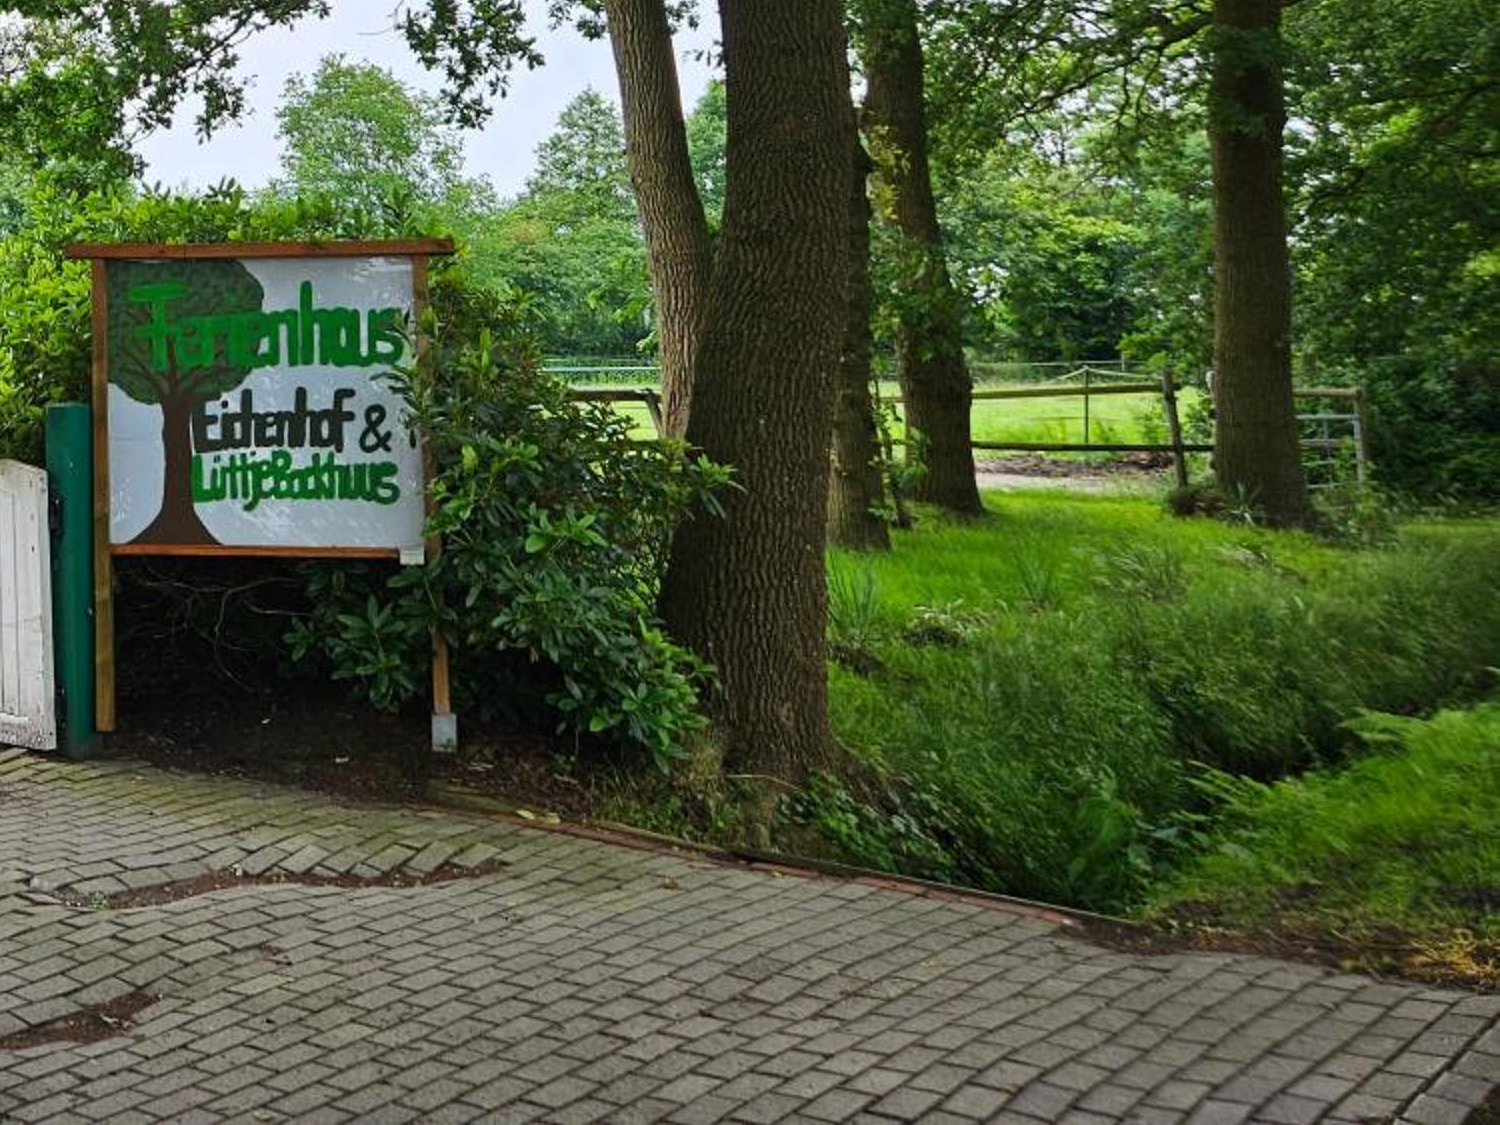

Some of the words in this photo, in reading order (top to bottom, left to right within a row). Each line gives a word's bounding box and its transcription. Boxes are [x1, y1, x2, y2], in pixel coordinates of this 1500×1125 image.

[128, 280, 404, 370] Ferienhaus
[194, 386, 356, 453] Eichenhof
[359, 403, 392, 453] &
